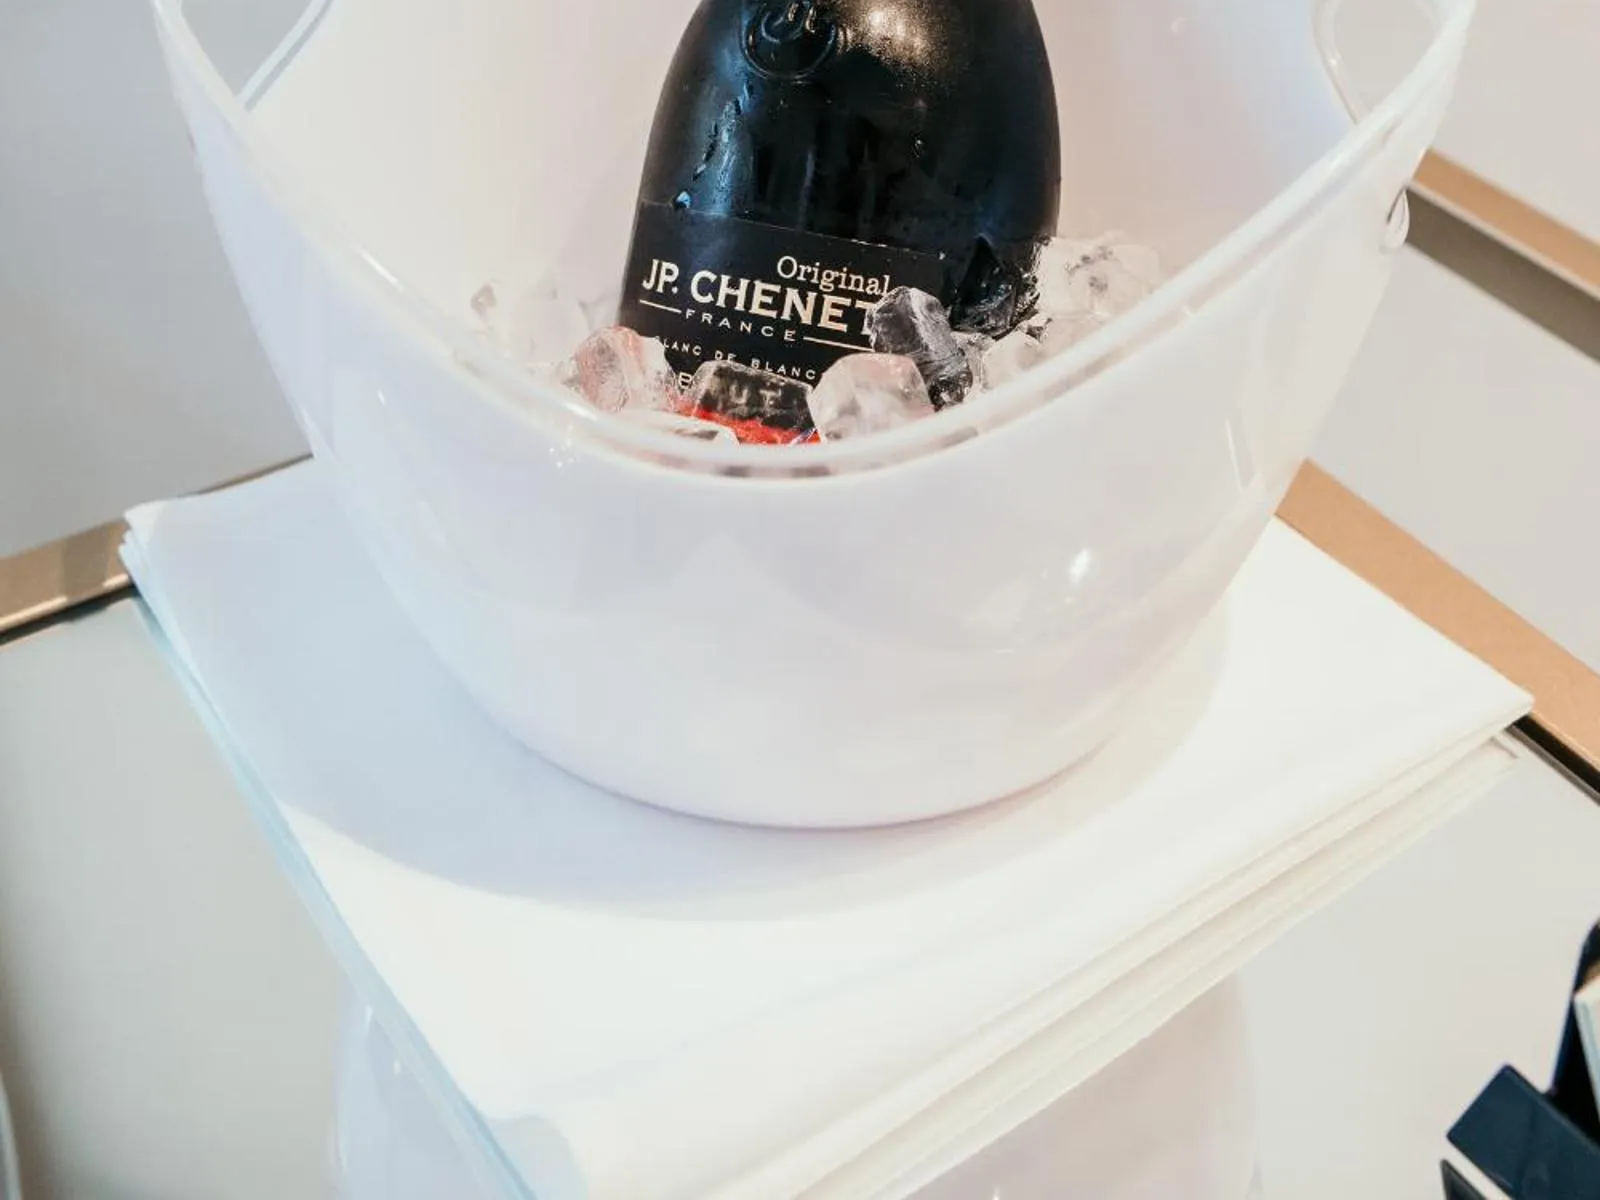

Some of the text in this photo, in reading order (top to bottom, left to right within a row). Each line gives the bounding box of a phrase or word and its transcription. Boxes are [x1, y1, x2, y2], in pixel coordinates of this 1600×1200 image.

[641, 258, 680, 295] JP.
[776, 255, 890, 296] Original
[685, 308, 796, 342] FRANCE
[656, 336, 702, 356] LANC
[714, 350, 737, 364] DE
